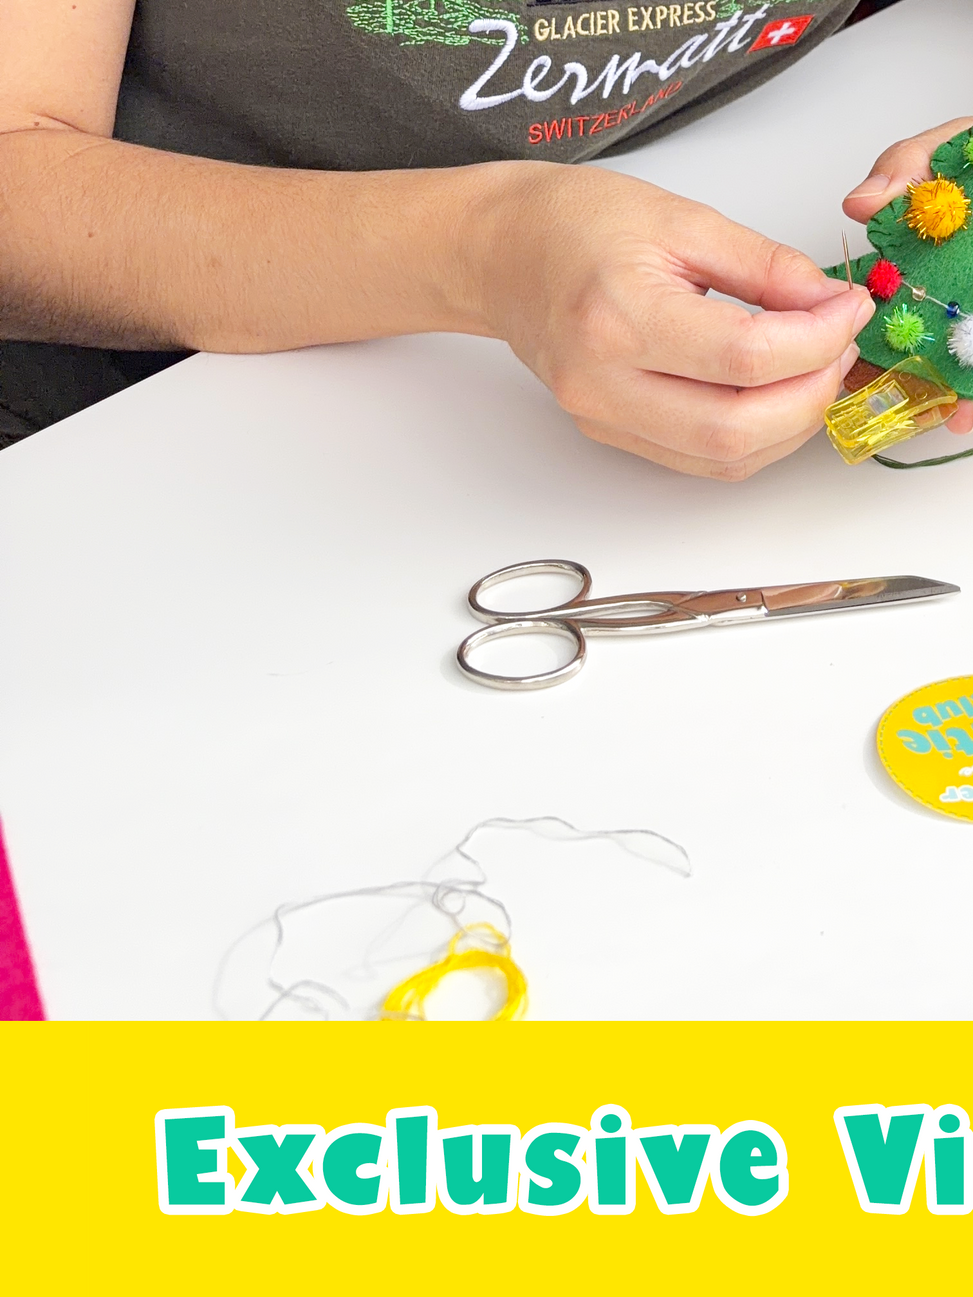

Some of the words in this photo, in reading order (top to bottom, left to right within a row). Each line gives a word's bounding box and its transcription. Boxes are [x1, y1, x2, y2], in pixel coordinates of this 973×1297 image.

[533, 8, 620, 43] GLACIER
[628, 0, 718, 32] EXPRESS
[459, 3, 769, 111] Zermatt
[528, 80, 684, 145] SWITZERLAND
